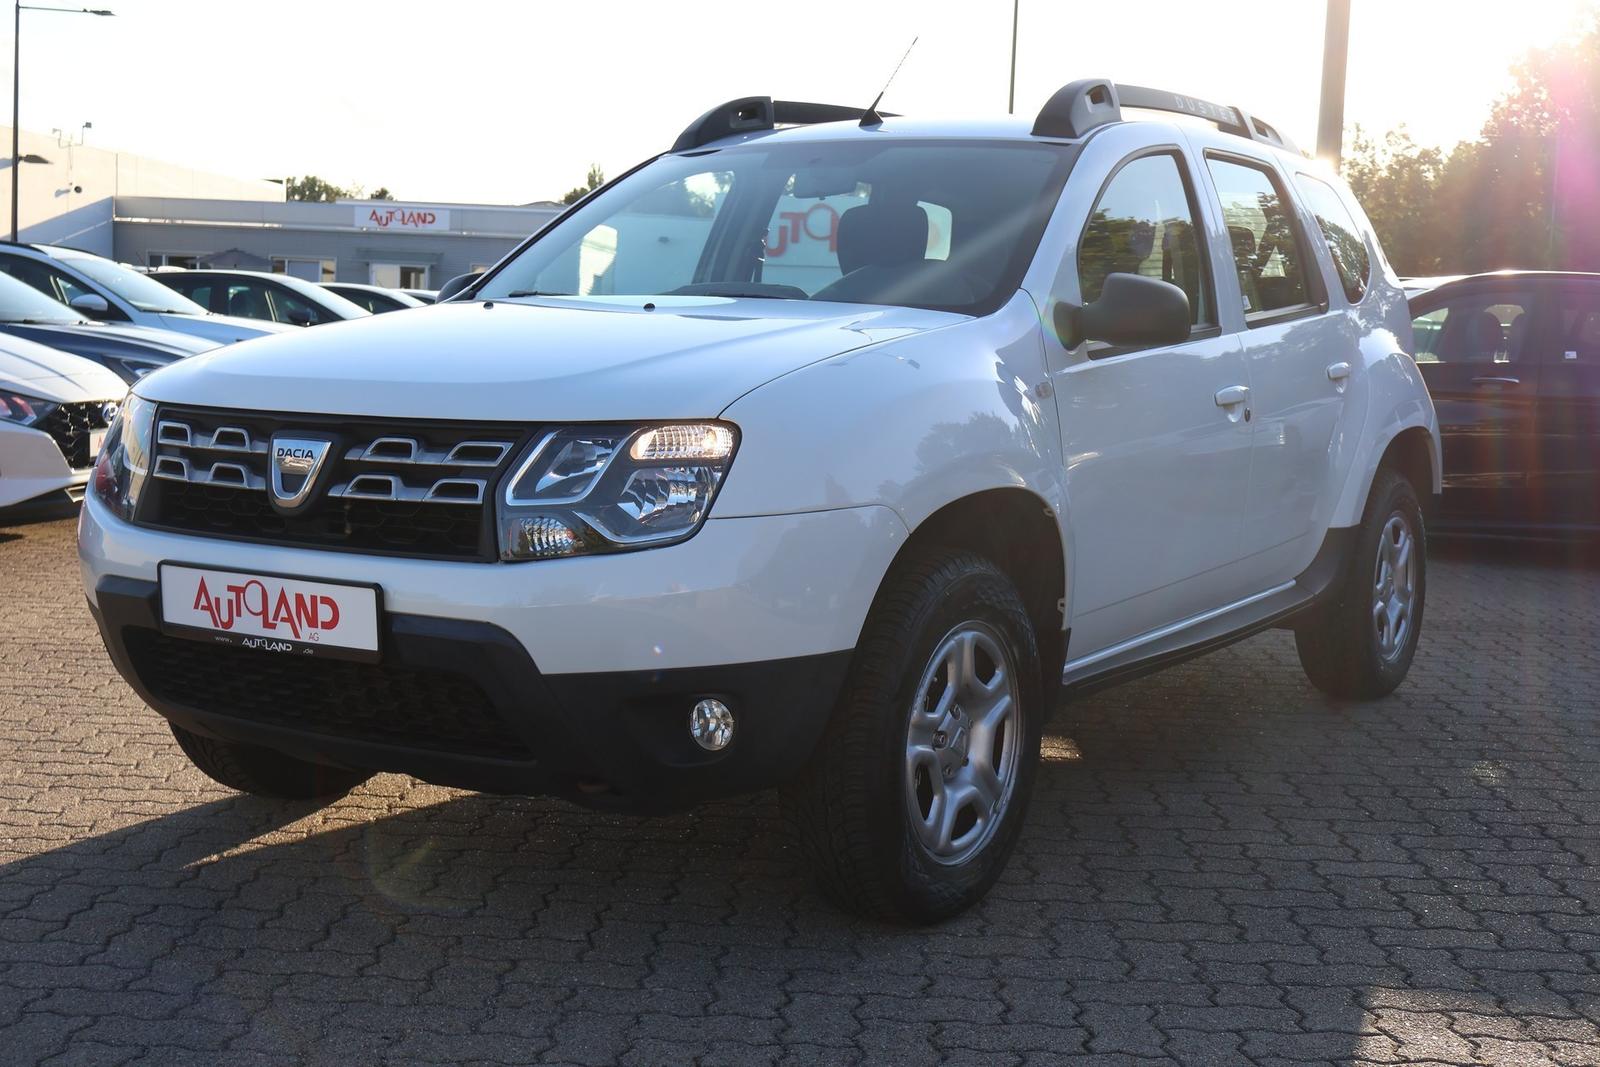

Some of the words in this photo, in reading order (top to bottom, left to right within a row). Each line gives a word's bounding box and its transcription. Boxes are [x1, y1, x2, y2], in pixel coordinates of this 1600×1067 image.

[369, 207, 436, 228] AUTOLAND
[277, 448, 314, 459] DACIA
[193, 576, 340, 640] AUTOLAND
[308, 632, 320, 642] AG
[242, 638, 293, 652] AUTOLAND
